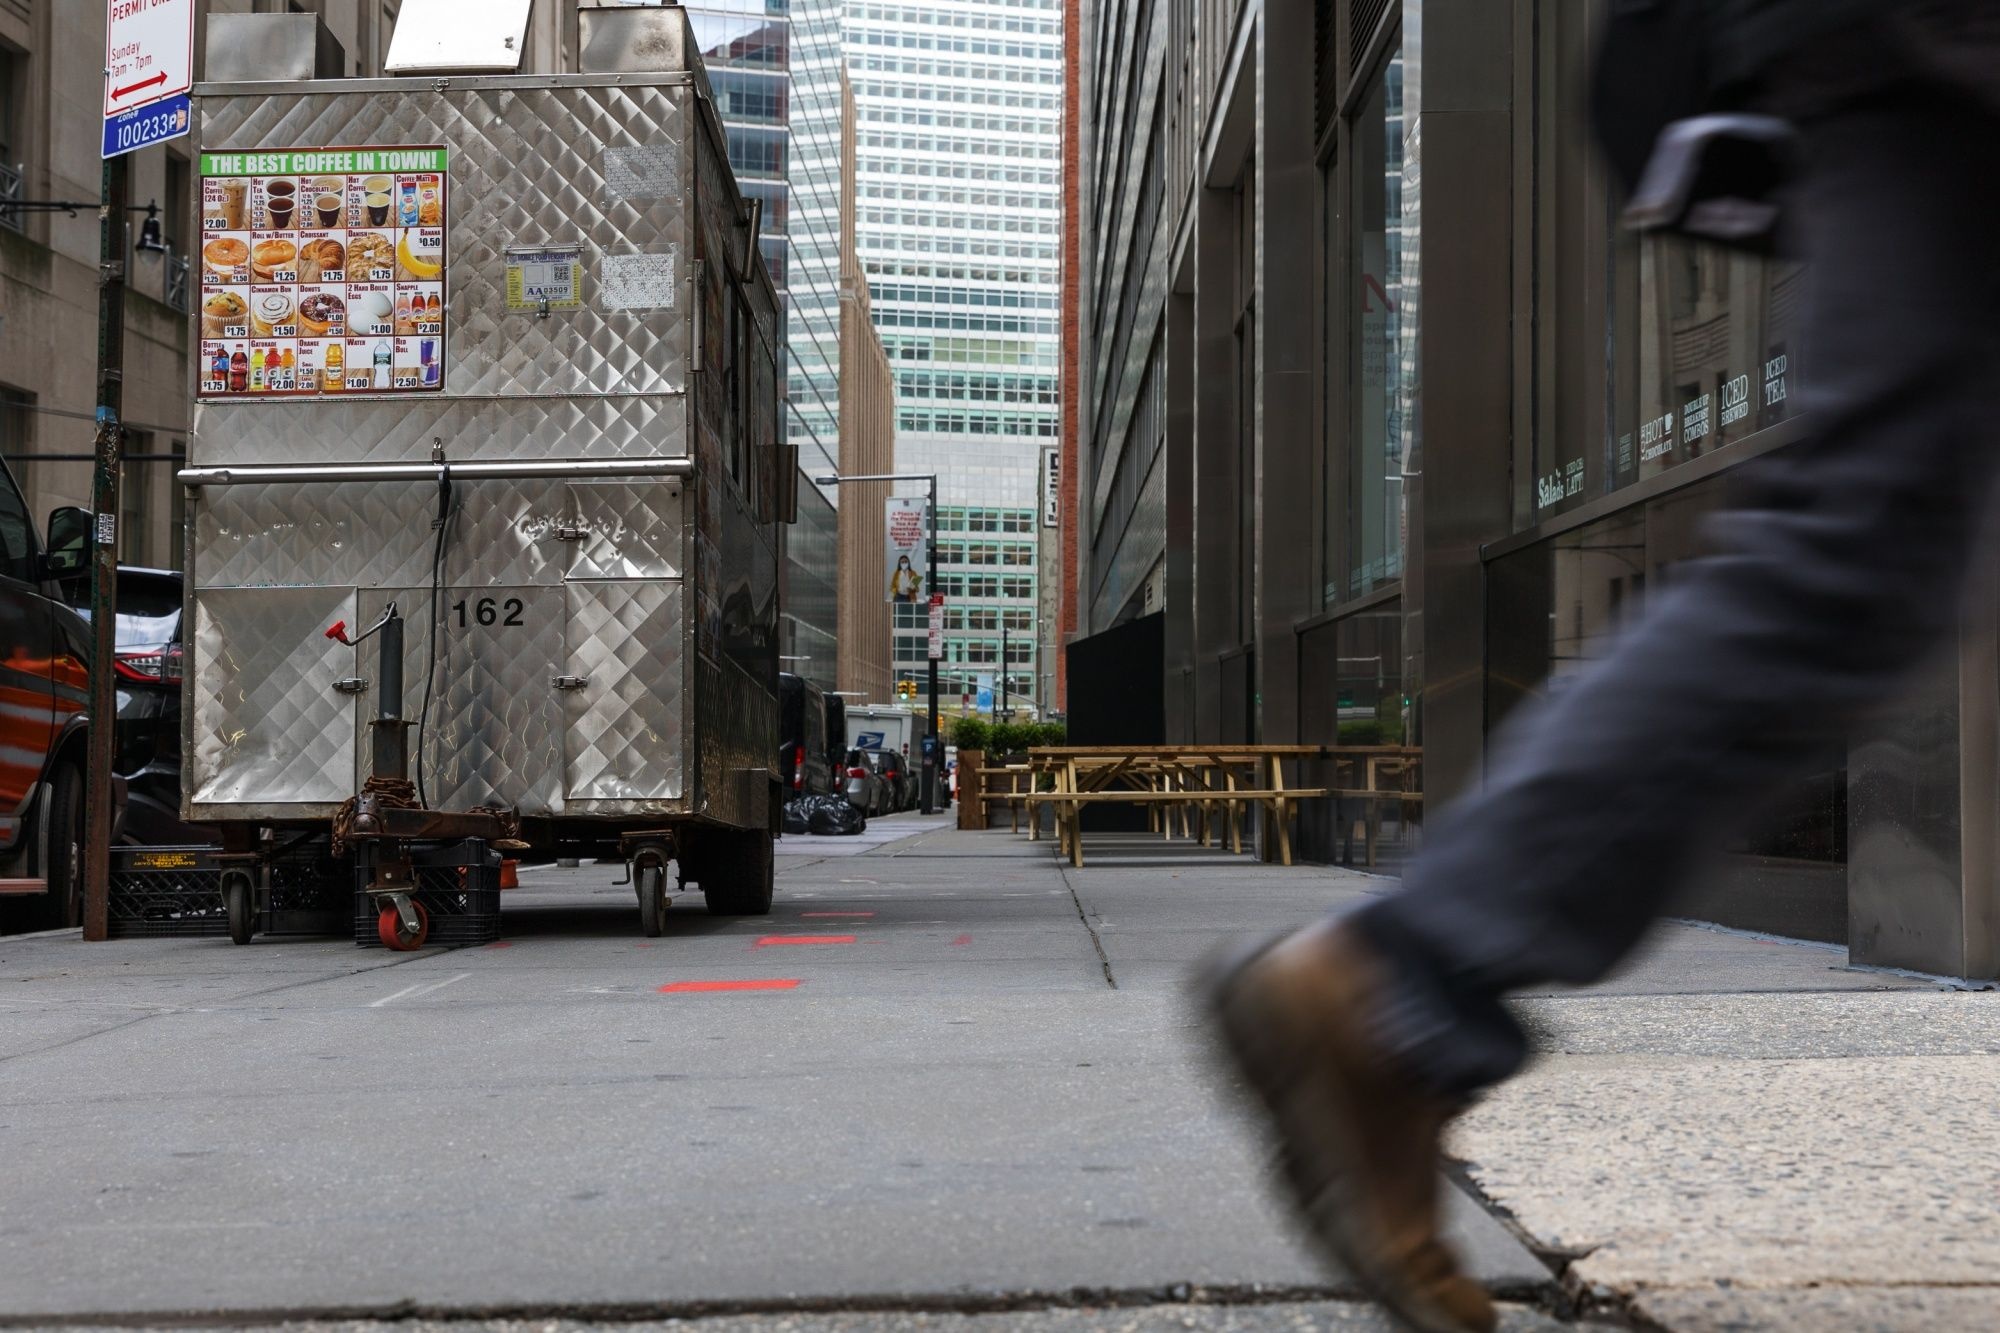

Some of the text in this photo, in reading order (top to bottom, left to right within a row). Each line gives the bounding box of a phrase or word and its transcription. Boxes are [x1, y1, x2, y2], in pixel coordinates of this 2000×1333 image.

[112, 0, 146, 22] PERMIT
[112, 42, 140, 61] Sunday
[112, 64, 126, 78] 7am
[135, 55, 152, 70] 7pm
[118, 113, 168, 148] 100233
[210, 152, 437, 173] THE BEST COFFEE IN TOWN!
[205, 219, 226, 228] $2.00
[420, 238, 440, 247] $0.50
[276, 272, 295, 281] $1.25
[324, 272, 342, 280] $1.75
[372, 270, 390, 279] $1.75
[227, 327, 246, 336] $1.75
[274, 326, 294, 335] $1.50
[371, 325, 390, 333] $1.00
[419, 324, 439, 332] $2.00
[1766, 354, 1786, 380] ICED
[204, 382, 222, 390] $1.75
[273, 380, 294, 389] $2.00
[347, 379, 367, 387] $1.00
[396, 378, 416, 386] $2.50
[1721, 374, 1748, 410] ICED
[1766, 377, 1786, 406] TEA
[1684, 398, 1702, 416] DOUBLE
[1721, 401, 1748, 426] BREWED
[1646, 416, 1664, 444] HOT
[1684, 420, 1709, 443] COMBOS
[1646, 439, 1672, 460] CHOCOLATE
[1538, 474, 1564, 509] Salads
[453, 598, 523, 627] 162
